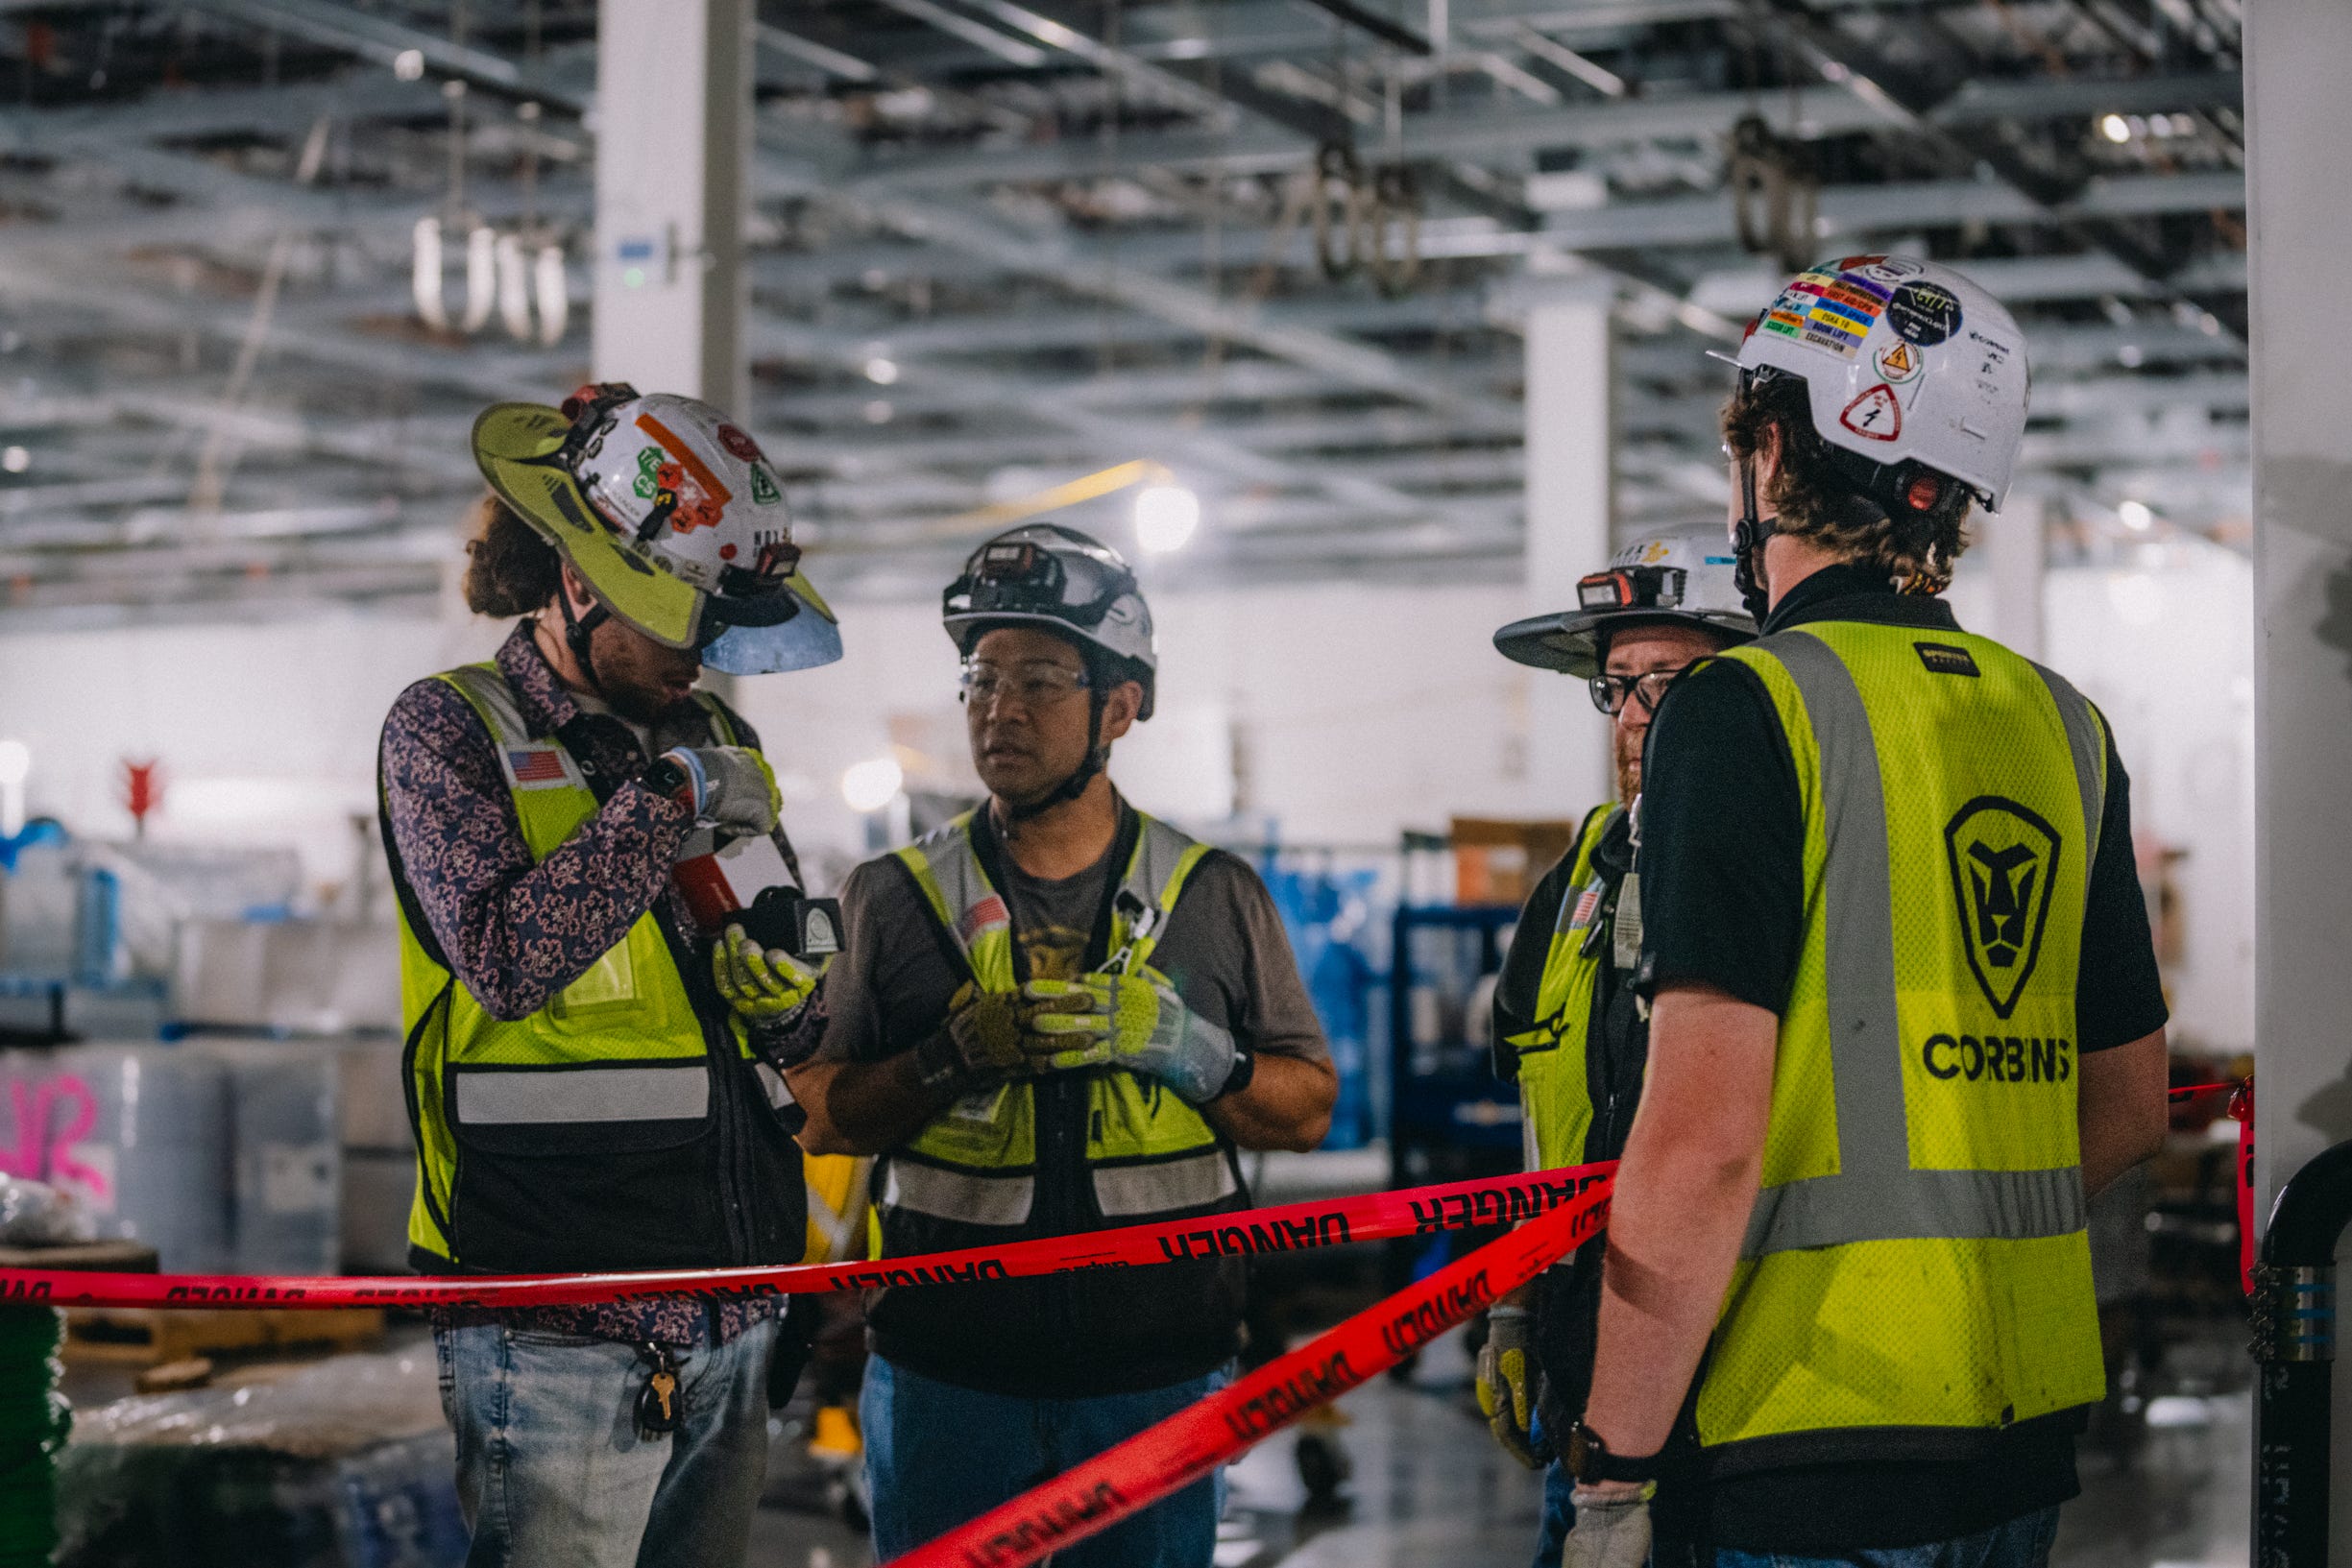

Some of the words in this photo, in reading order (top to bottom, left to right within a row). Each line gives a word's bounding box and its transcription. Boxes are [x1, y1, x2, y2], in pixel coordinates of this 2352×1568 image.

[1806, 331, 1845, 352] EXCAVATION
[640, 448, 663, 472] T/E
[636, 474, 656, 495] CS
[1922, 1033, 2071, 1083] CORBINS
[1156, 1211, 1352, 1265] DANGER
